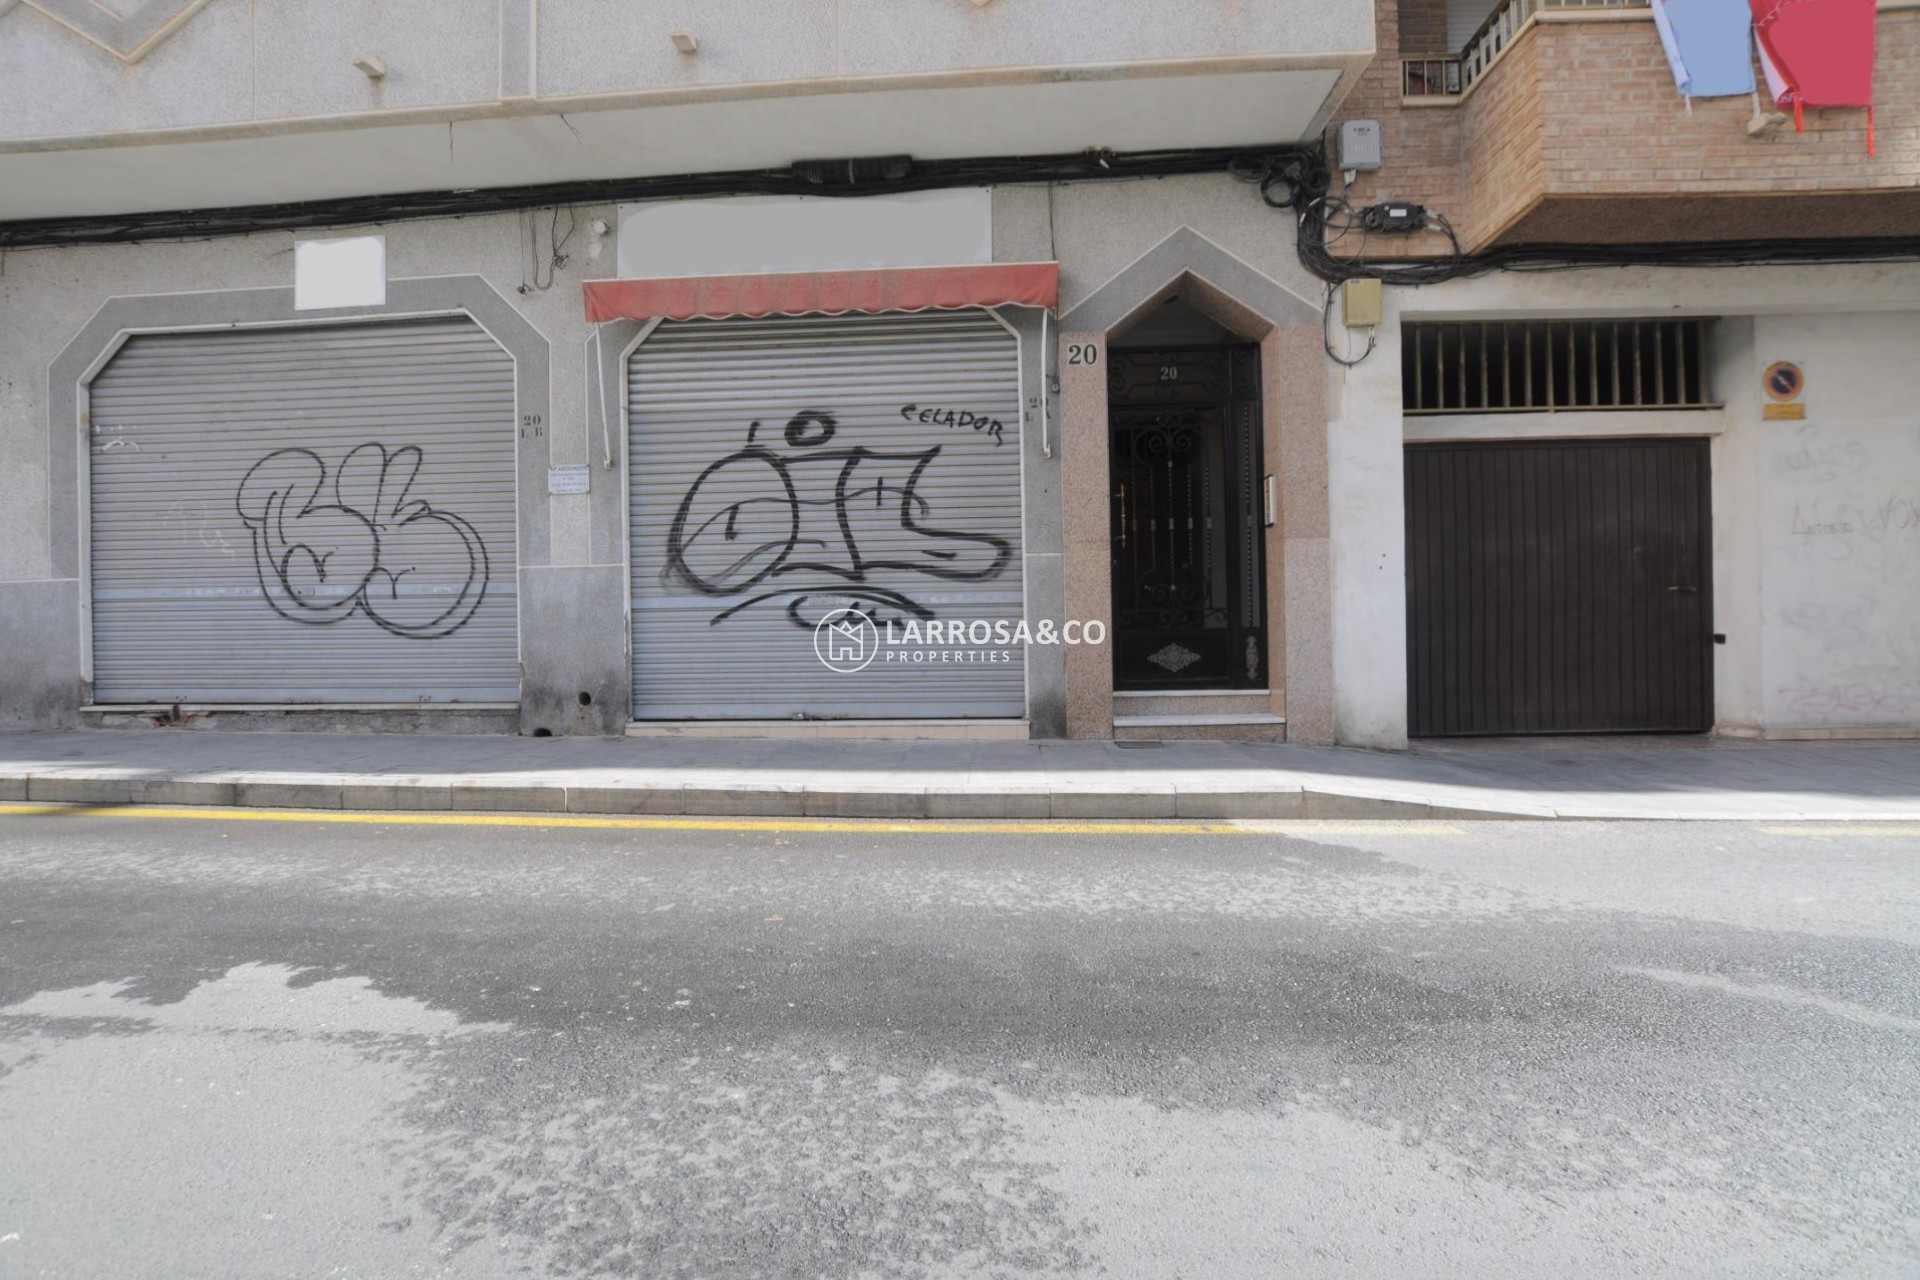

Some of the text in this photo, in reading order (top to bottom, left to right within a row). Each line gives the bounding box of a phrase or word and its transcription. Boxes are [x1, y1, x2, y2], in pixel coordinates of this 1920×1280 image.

[1068, 344, 1098, 365] 20
[1160, 366, 1178, 380] 20
[901, 404, 1003, 447] CELADOR
